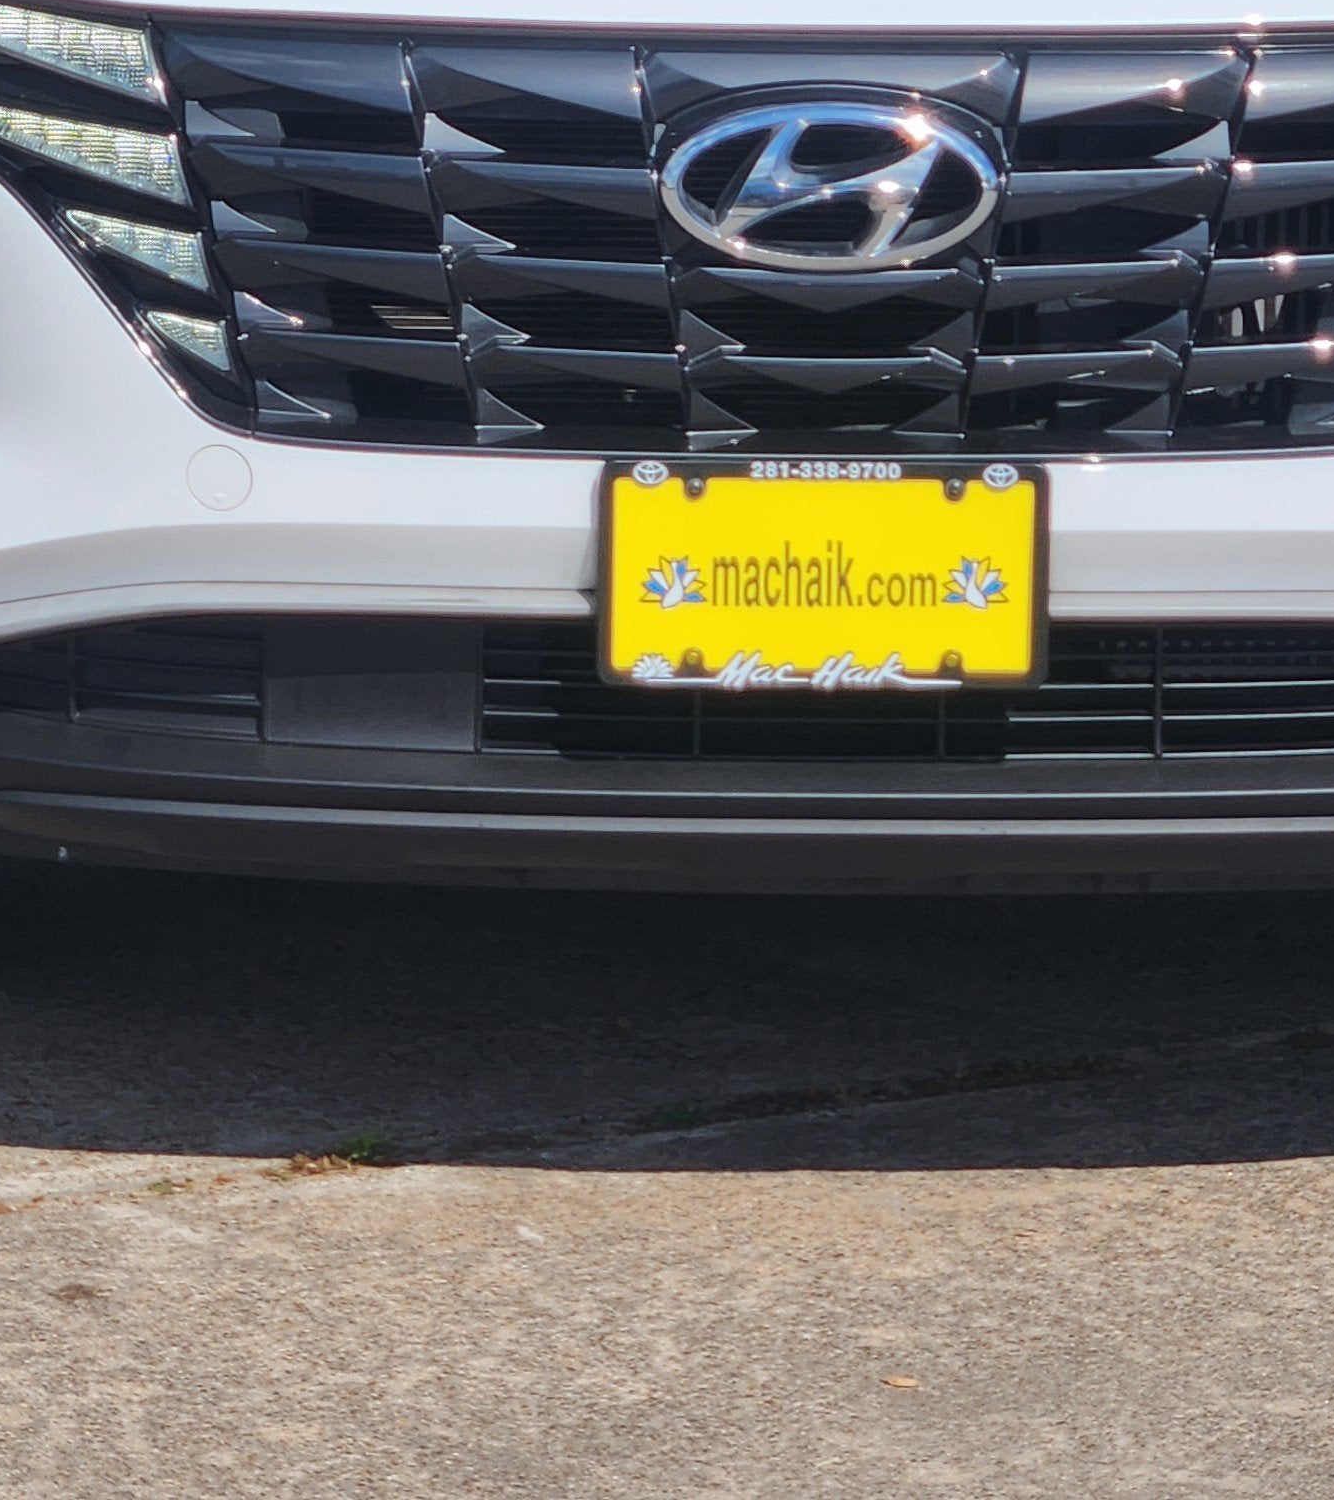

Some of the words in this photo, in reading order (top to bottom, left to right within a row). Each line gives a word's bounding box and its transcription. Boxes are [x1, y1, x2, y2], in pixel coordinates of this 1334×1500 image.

[750, 461, 902, 481] 281-338-9700
[711, 541, 937, 608] machaik.com
[714, 650, 807, 688] Mac
